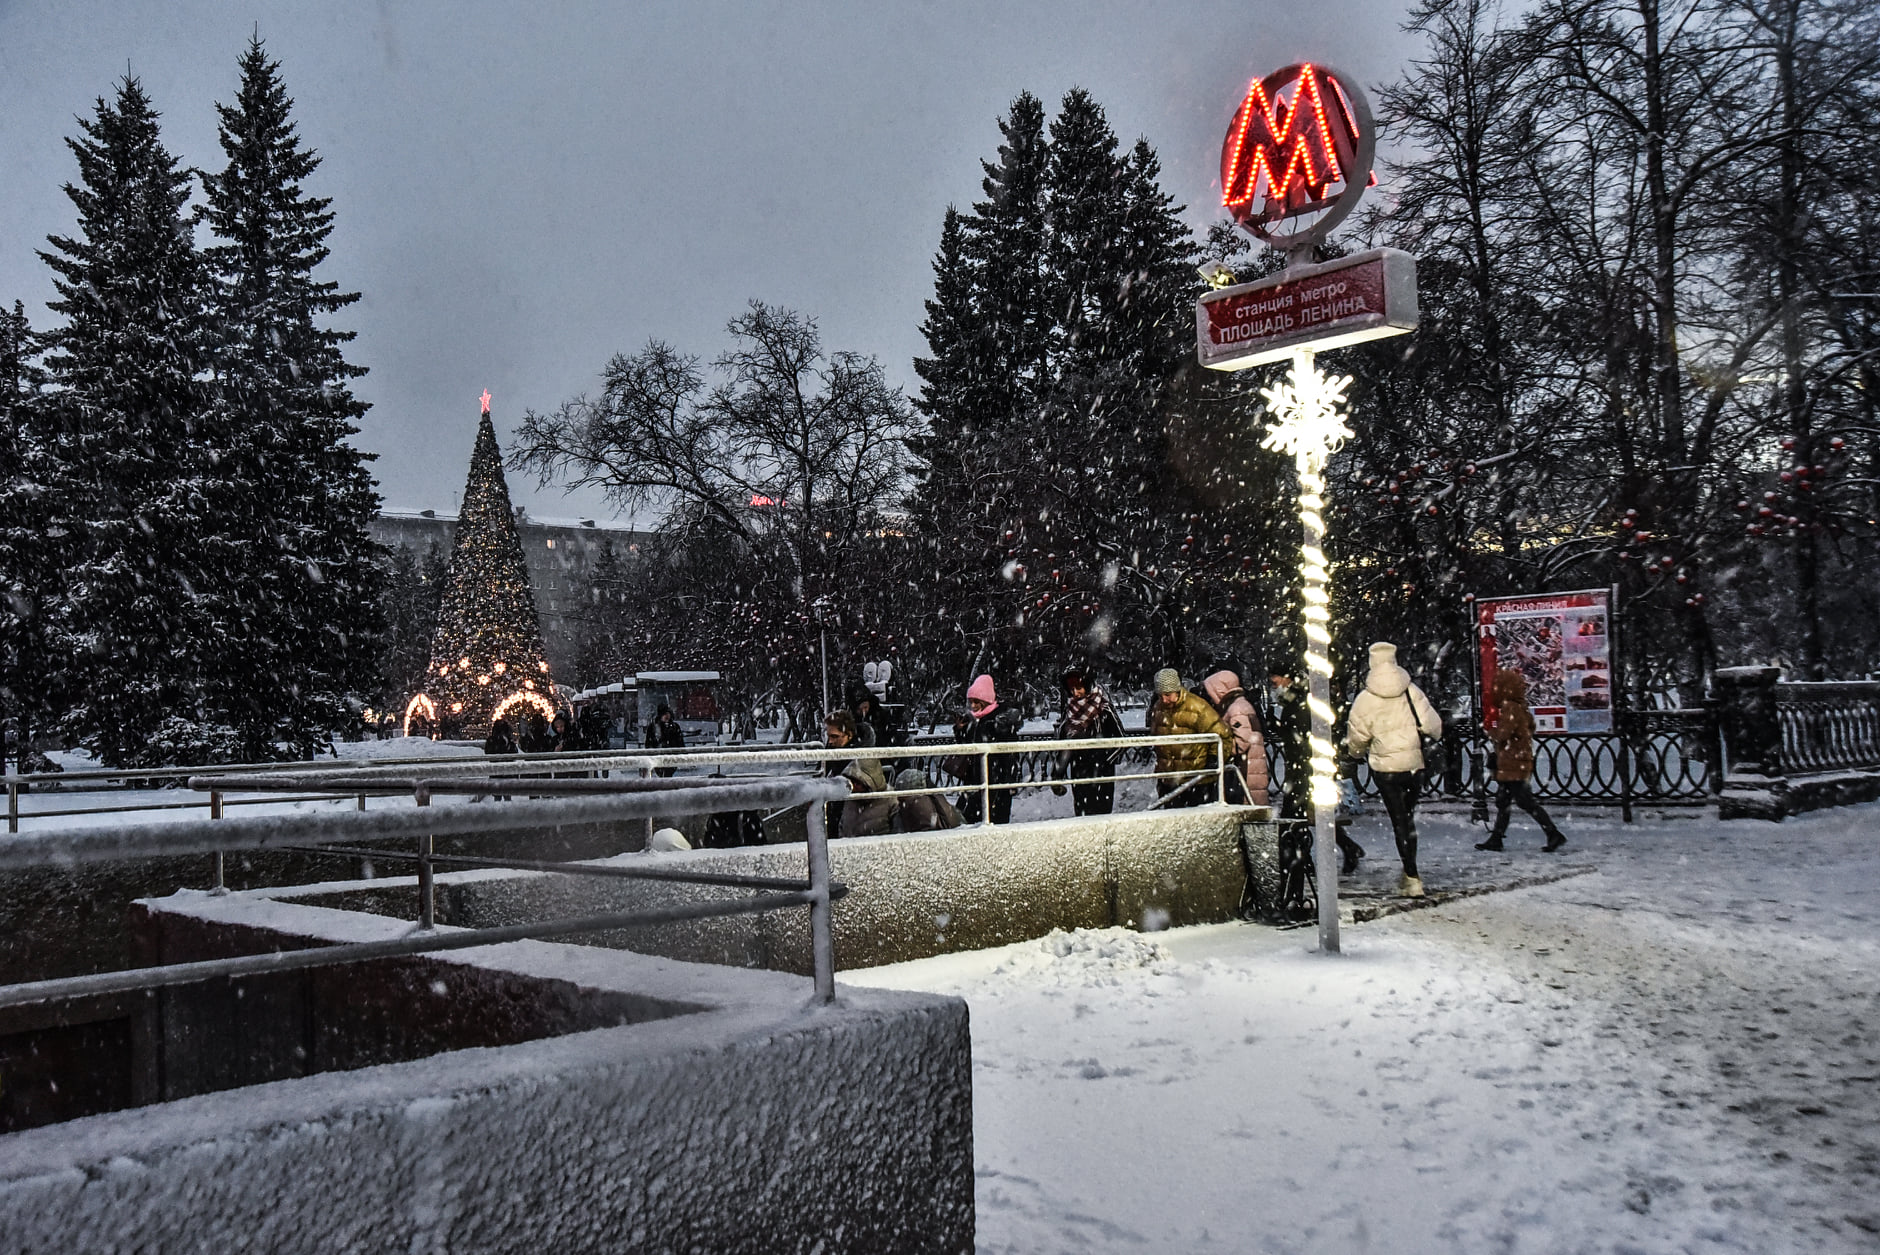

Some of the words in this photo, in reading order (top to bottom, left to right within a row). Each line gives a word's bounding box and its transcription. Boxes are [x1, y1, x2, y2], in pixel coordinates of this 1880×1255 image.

[1220, 314, 1293, 343] ПЛОЩАДЬ
[1301, 295, 1366, 324] ЛЕНИНА
[1236, 294, 1293, 319] станция
[1300, 281, 1347, 304] метро
[1496, 602, 1534, 613] КРАСНАЯ
